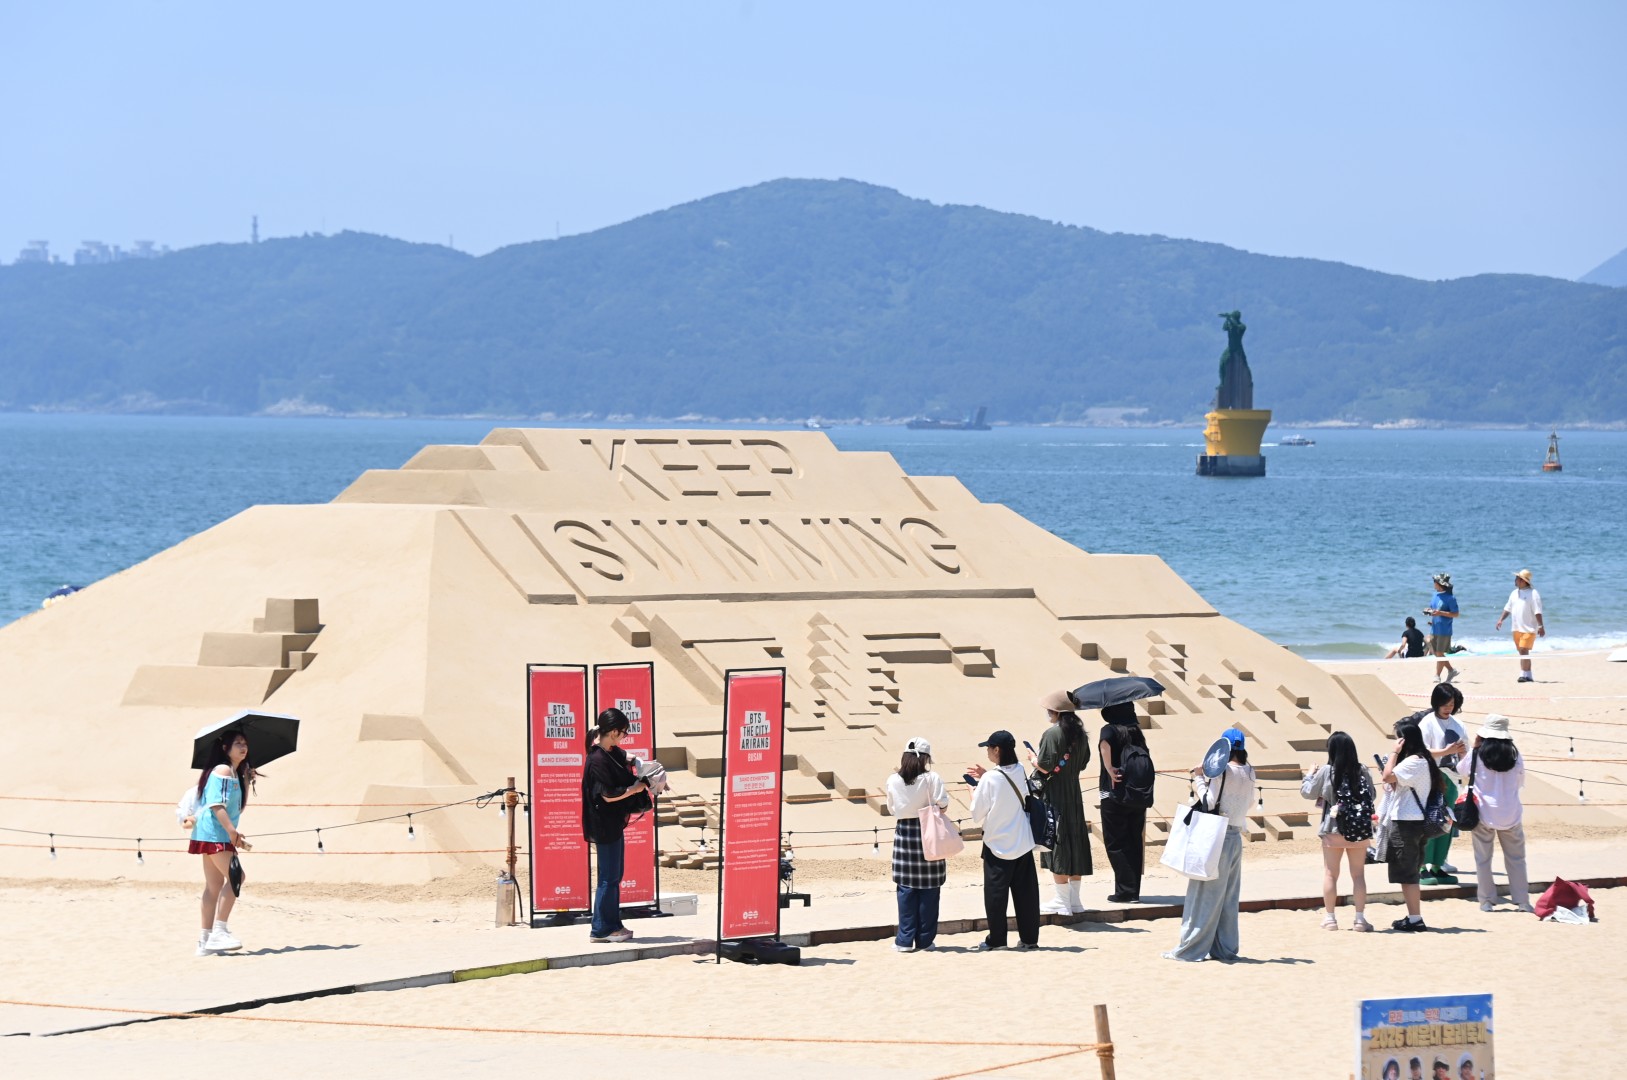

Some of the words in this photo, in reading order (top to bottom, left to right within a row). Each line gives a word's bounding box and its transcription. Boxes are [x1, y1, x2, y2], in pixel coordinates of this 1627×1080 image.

[579, 438, 803, 501] KEEP
[553, 516, 981, 582] SWIMMING
[553, 704, 566, 715] BTS
[620, 700, 632, 710] BTS
[547, 716, 558, 727] THE
[559, 716, 573, 727] CITY
[749, 712, 762, 724] BTS
[546, 728, 574, 738] ARIRANG
[743, 726, 754, 737] THE
[755, 724, 769, 736] CITY
[741, 737, 769, 750] ARIRANG
[747, 752, 763, 762] BUSAN
